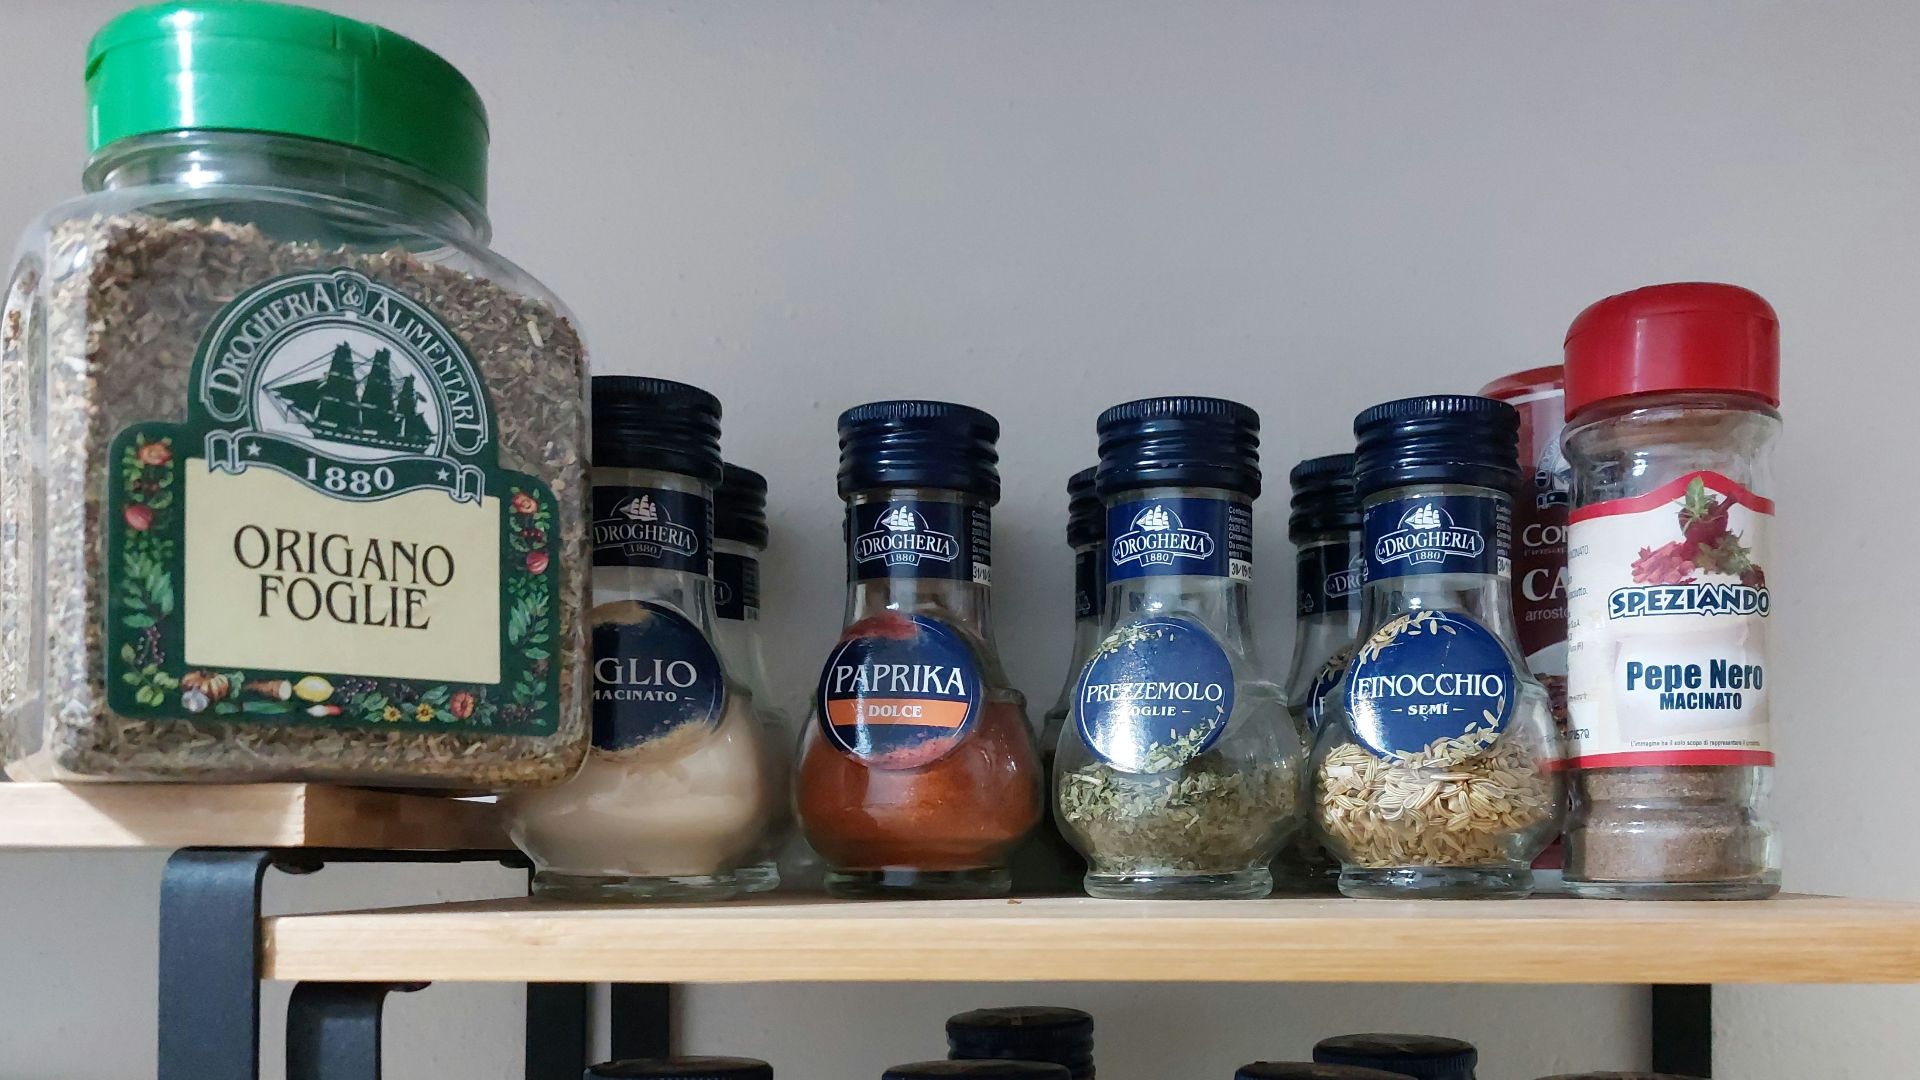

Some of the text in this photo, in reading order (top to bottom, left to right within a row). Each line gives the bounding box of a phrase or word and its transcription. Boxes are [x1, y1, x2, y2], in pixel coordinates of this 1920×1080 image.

[209, 279, 483, 433] DROGHERIA & ALIMENTARI
[306, 456, 396, 495] 1880
[594, 523, 691, 550] DROGHERIA
[629, 543, 657, 555] 1880
[861, 533, 951, 557] DROGHERIA
[1119, 533, 1205, 558] DROGHERIA
[1384, 531, 1476, 557] DROGHERIA
[233, 523, 455, 587] ORIGANO
[890, 553, 916, 563] 1880
[1145, 552, 1169, 563] 1880
[1415, 550, 1441, 561] 1880
[258, 574, 430, 630] FOGLIE
[1610, 585, 1770, 617] SPEZIANDO
[594, 657, 698, 688] GLIO
[834, 664, 967, 696] PAPRIKA
[1626, 658, 1763, 692] Pepe Nero
[1086, 681, 1223, 703] PREZZEMOLO
[1357, 673, 1504, 699] FINOCCHIO
[868, 705, 923, 718] DOLCE
[1407, 703, 1449, 716] SEMI
[1659, 692, 1742, 710] MACINATO
